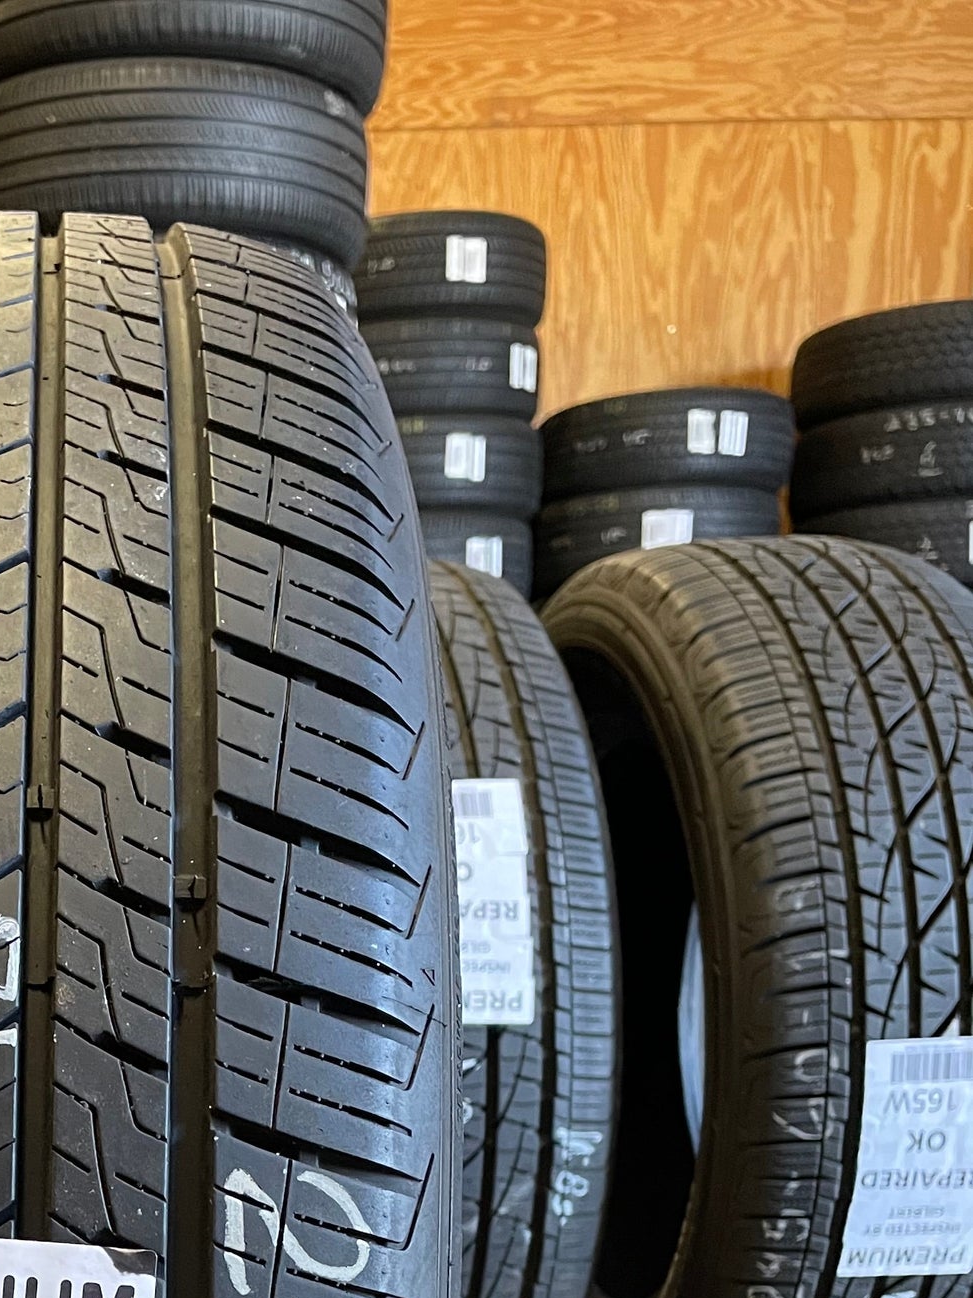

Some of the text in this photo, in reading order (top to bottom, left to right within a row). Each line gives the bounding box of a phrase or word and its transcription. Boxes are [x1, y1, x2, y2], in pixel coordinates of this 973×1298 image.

[883, 1087, 958, 1114] 165W
[907, 1127, 947, 1153] OK
[847, 1245, 967, 1267] PREMIUM
